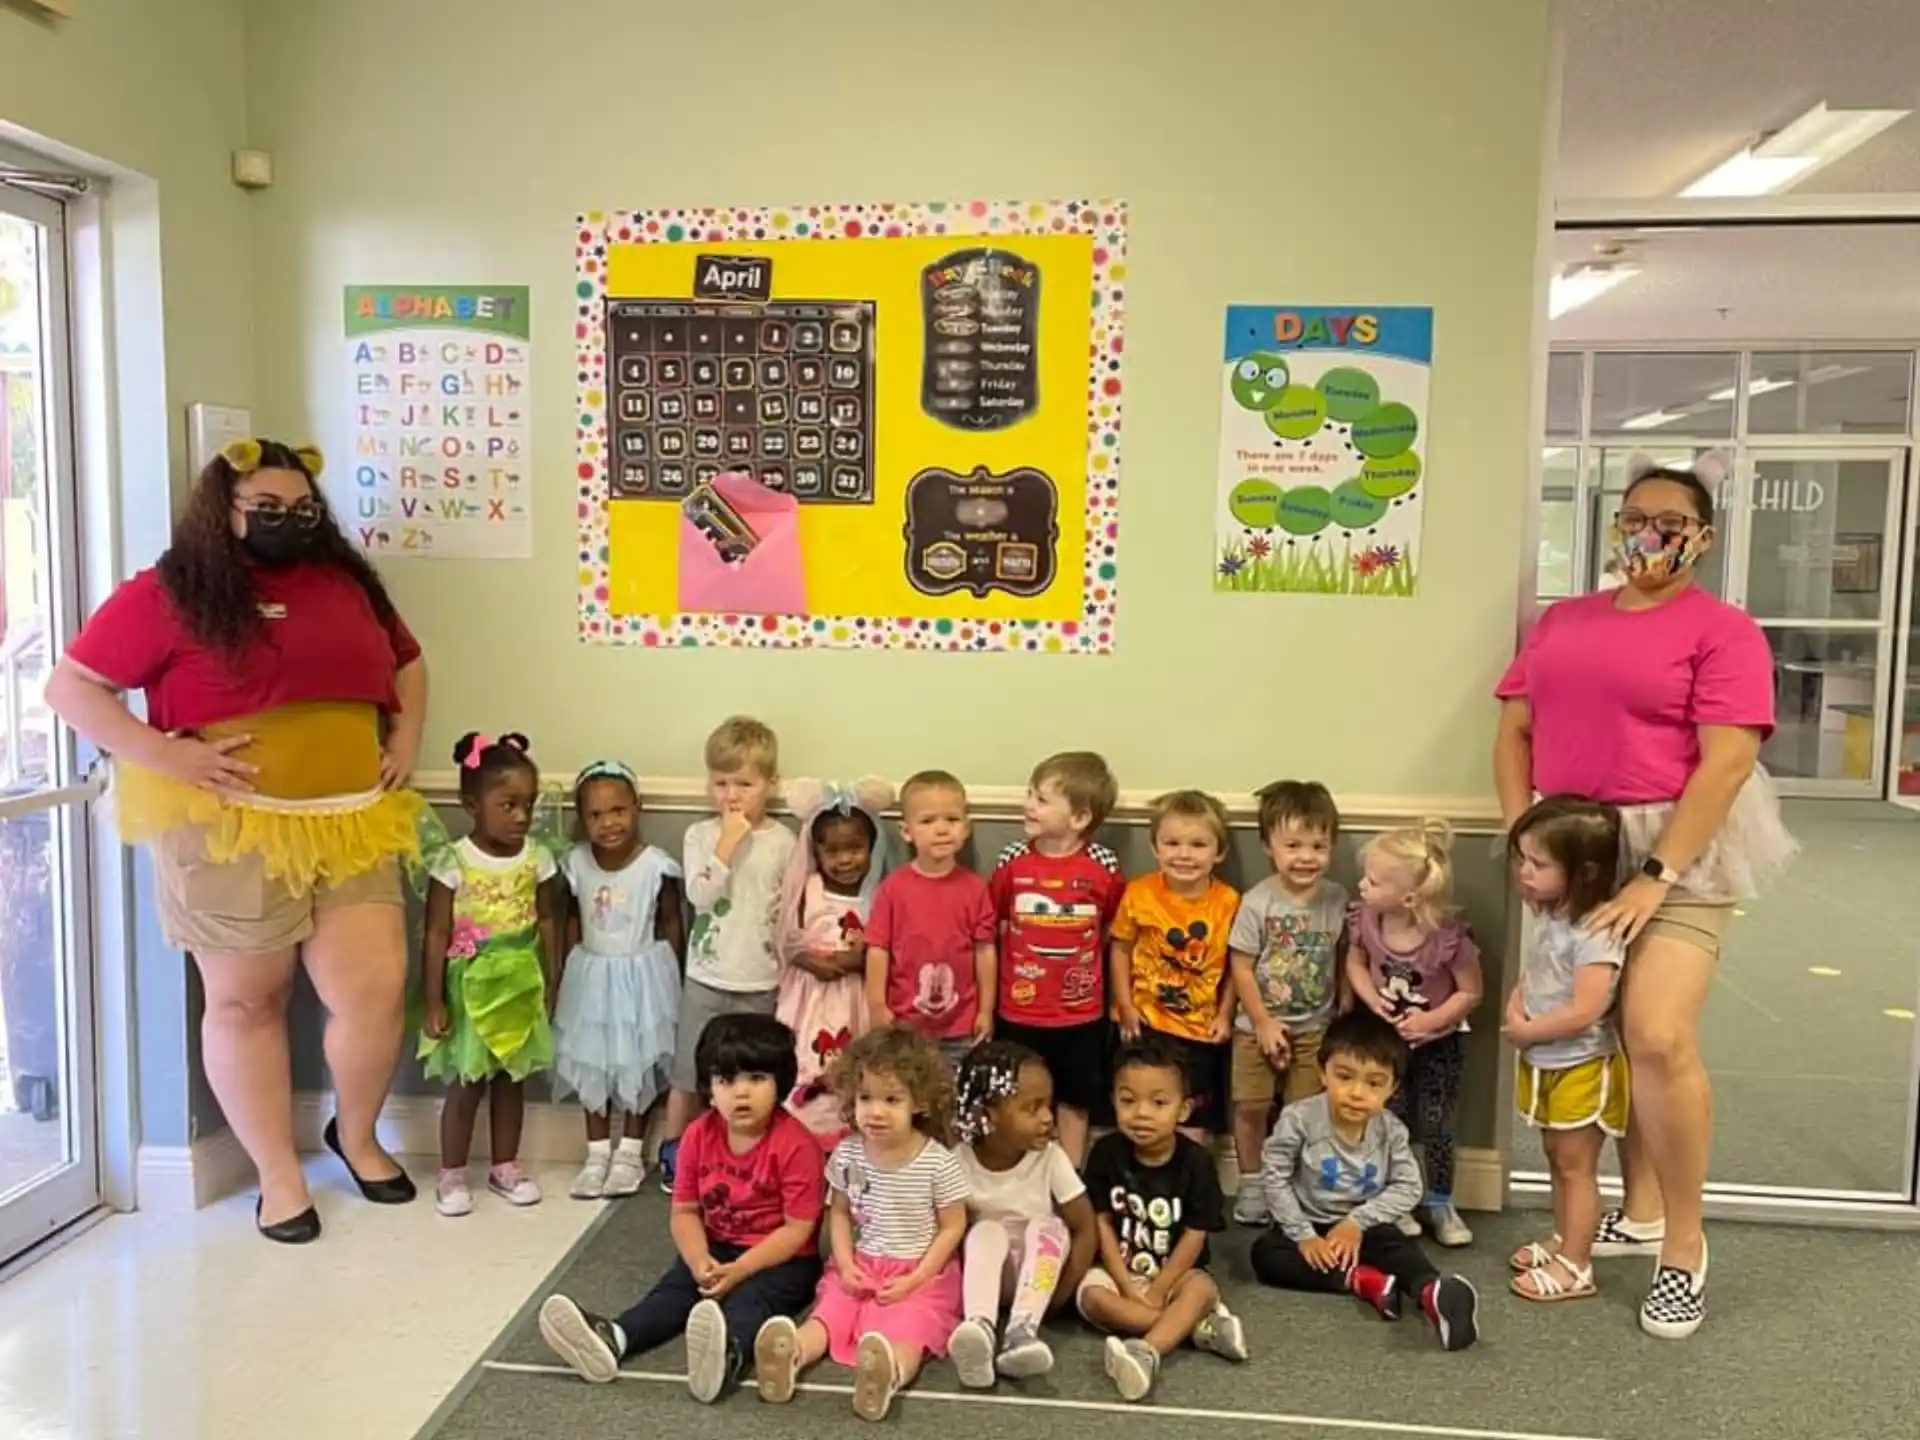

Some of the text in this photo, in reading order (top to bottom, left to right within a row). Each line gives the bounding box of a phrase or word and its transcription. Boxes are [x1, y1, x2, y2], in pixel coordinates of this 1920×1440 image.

[703, 264, 761, 290] April
[357, 296, 516, 320] ALPHABET
[771, 329, 850, 344] 1 2 3
[1275, 312, 1378, 344] DAYS
[355, 342, 503, 364] A B C D
[629, 364, 854, 380] 4 5 6 7 8 9 10
[358, 374, 503, 394] E F G H
[360, 406, 503, 427] I J K L
[626, 399, 854, 417] 11 12 13 15 16 17
[358, 437, 503, 457] M N O P
[625, 435, 856, 451] 18 19 20 21 22 23 24
[1237, 449, 1270, 461] There
[357, 466, 504, 489] Q R S T
[623, 468, 644, 482] 25
[662, 469, 682, 483] 26
[359, 498, 505, 520] U V W X
[360, 528, 418, 548] Y Z
